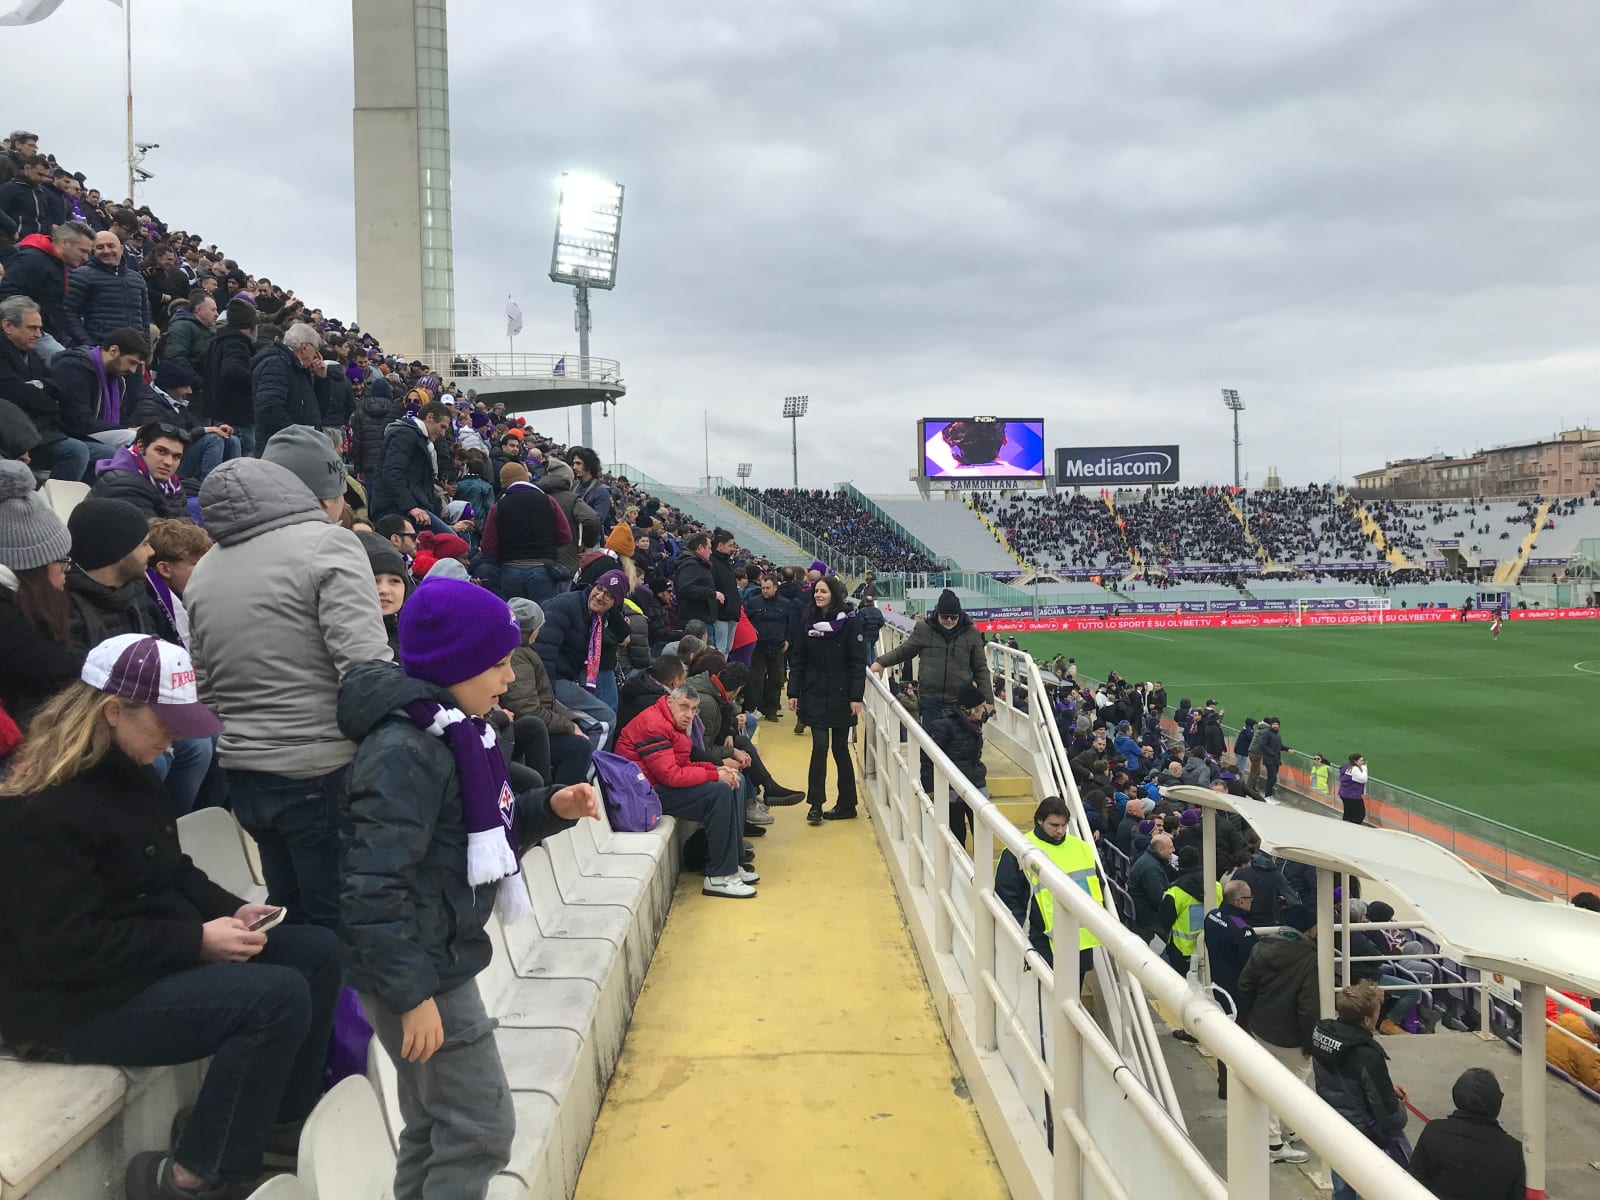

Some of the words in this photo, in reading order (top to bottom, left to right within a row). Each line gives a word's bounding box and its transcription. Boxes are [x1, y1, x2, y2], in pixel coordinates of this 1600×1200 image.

[1066, 457, 1161, 477] Mediacom
[950, 480, 1018, 489] SAMMONTANA
[1349, 615, 1376, 623] SPORT
[1077, 621, 1104, 629] TUTTO
[1105, 621, 1117, 629] LO
[1118, 620, 1145, 628] SPORT
